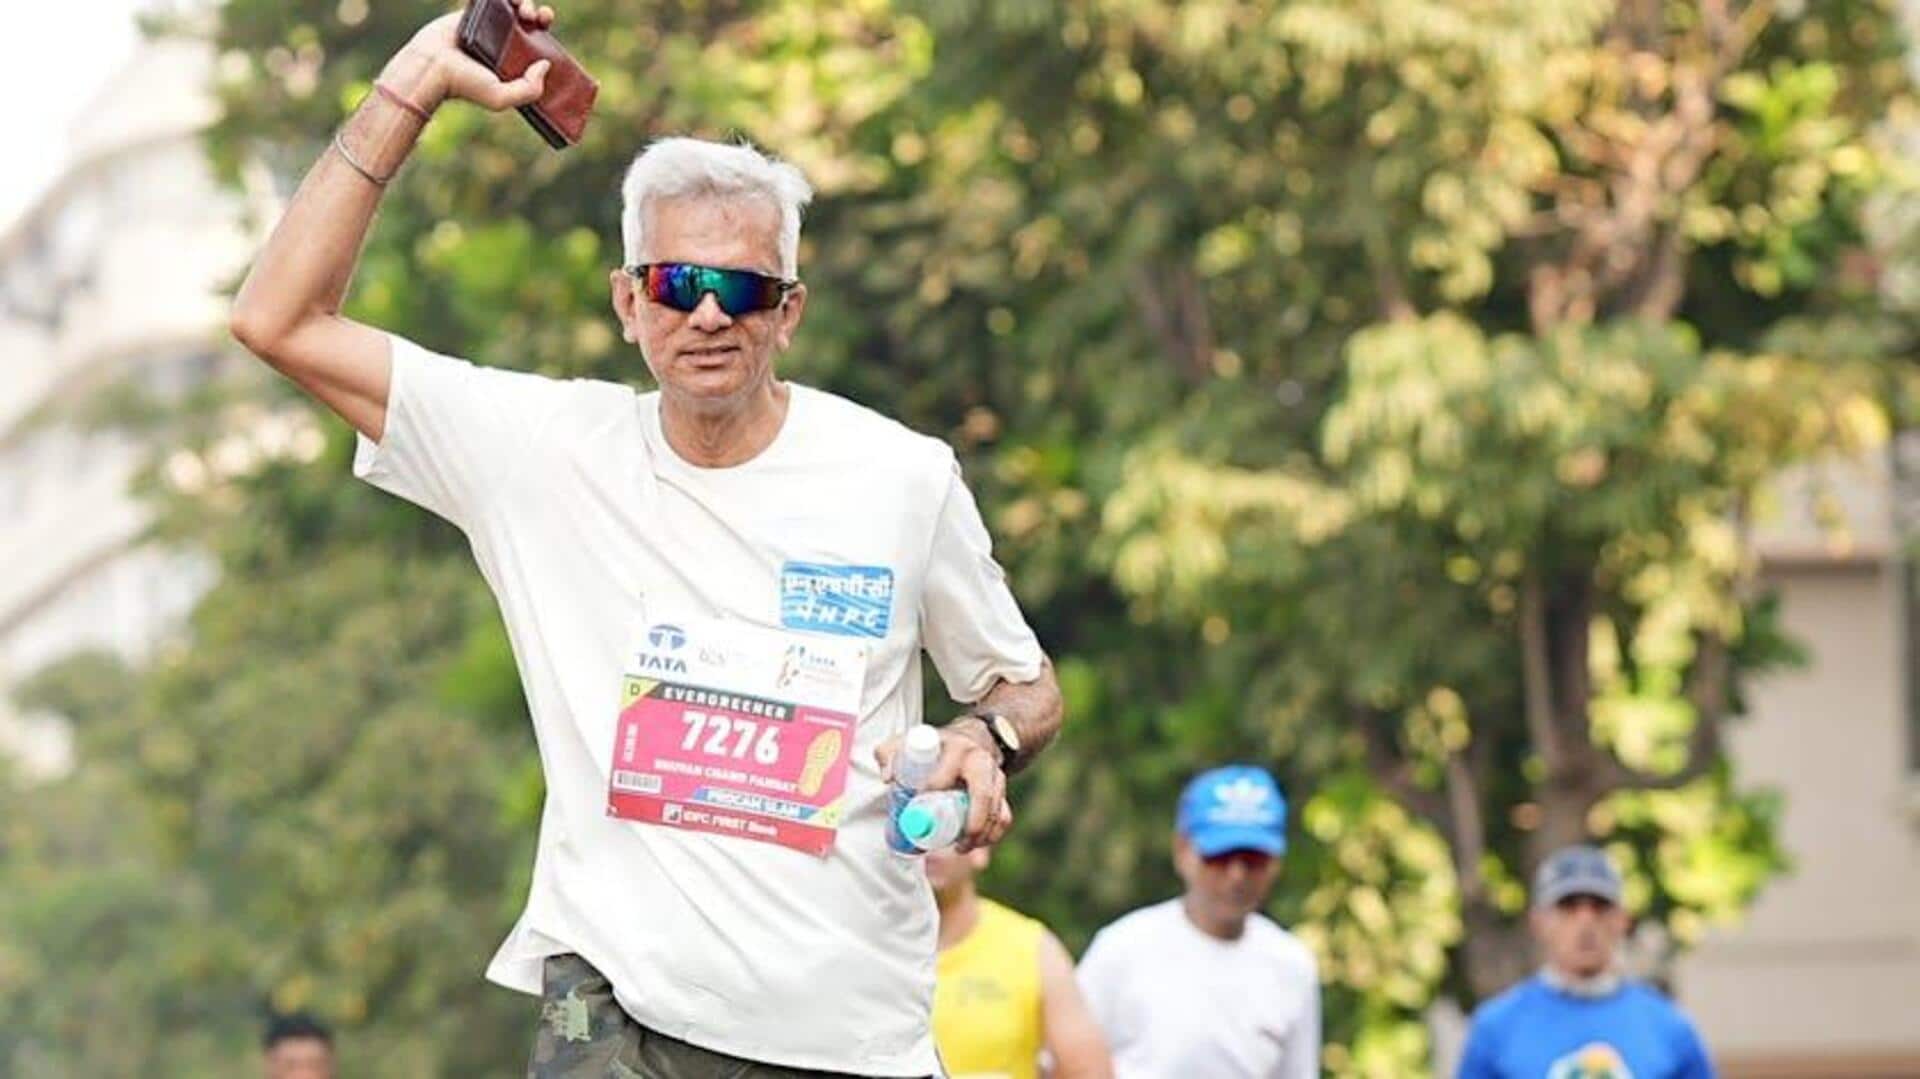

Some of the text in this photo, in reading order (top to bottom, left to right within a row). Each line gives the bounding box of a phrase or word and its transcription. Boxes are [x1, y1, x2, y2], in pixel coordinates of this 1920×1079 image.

[635, 652, 687, 673] TATA
[630, 683, 641, 697] D
[663, 686, 787, 719] EVERGREENER
[681, 711, 780, 765] 7276
